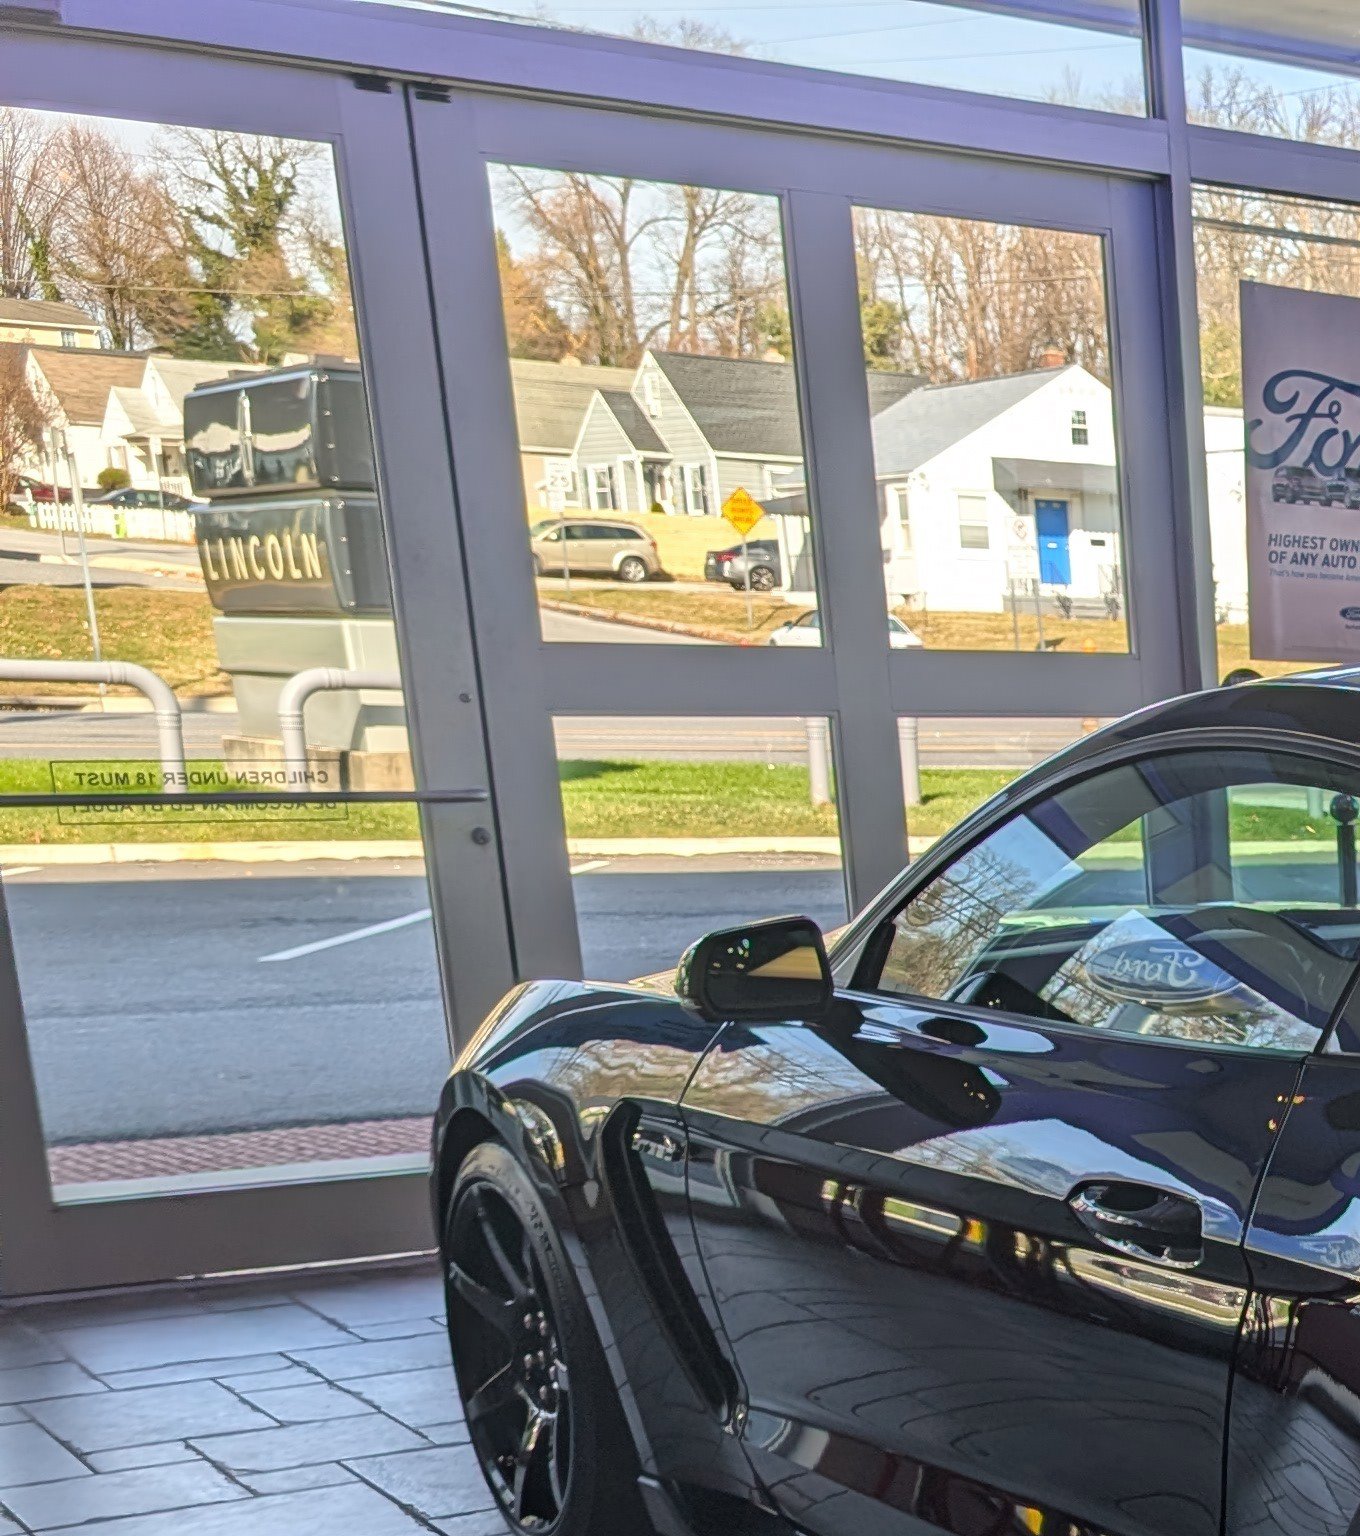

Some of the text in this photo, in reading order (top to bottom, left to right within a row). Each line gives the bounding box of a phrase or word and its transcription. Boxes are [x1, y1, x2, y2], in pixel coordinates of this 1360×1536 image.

[1267, 533, 1326, 550] HIGHEST
[203, 532, 322, 580] LINCOLN
[1268, 551, 1287, 564] OF
[1290, 552, 1319, 567] ANY
[1321, 555, 1357, 569] AUTO
